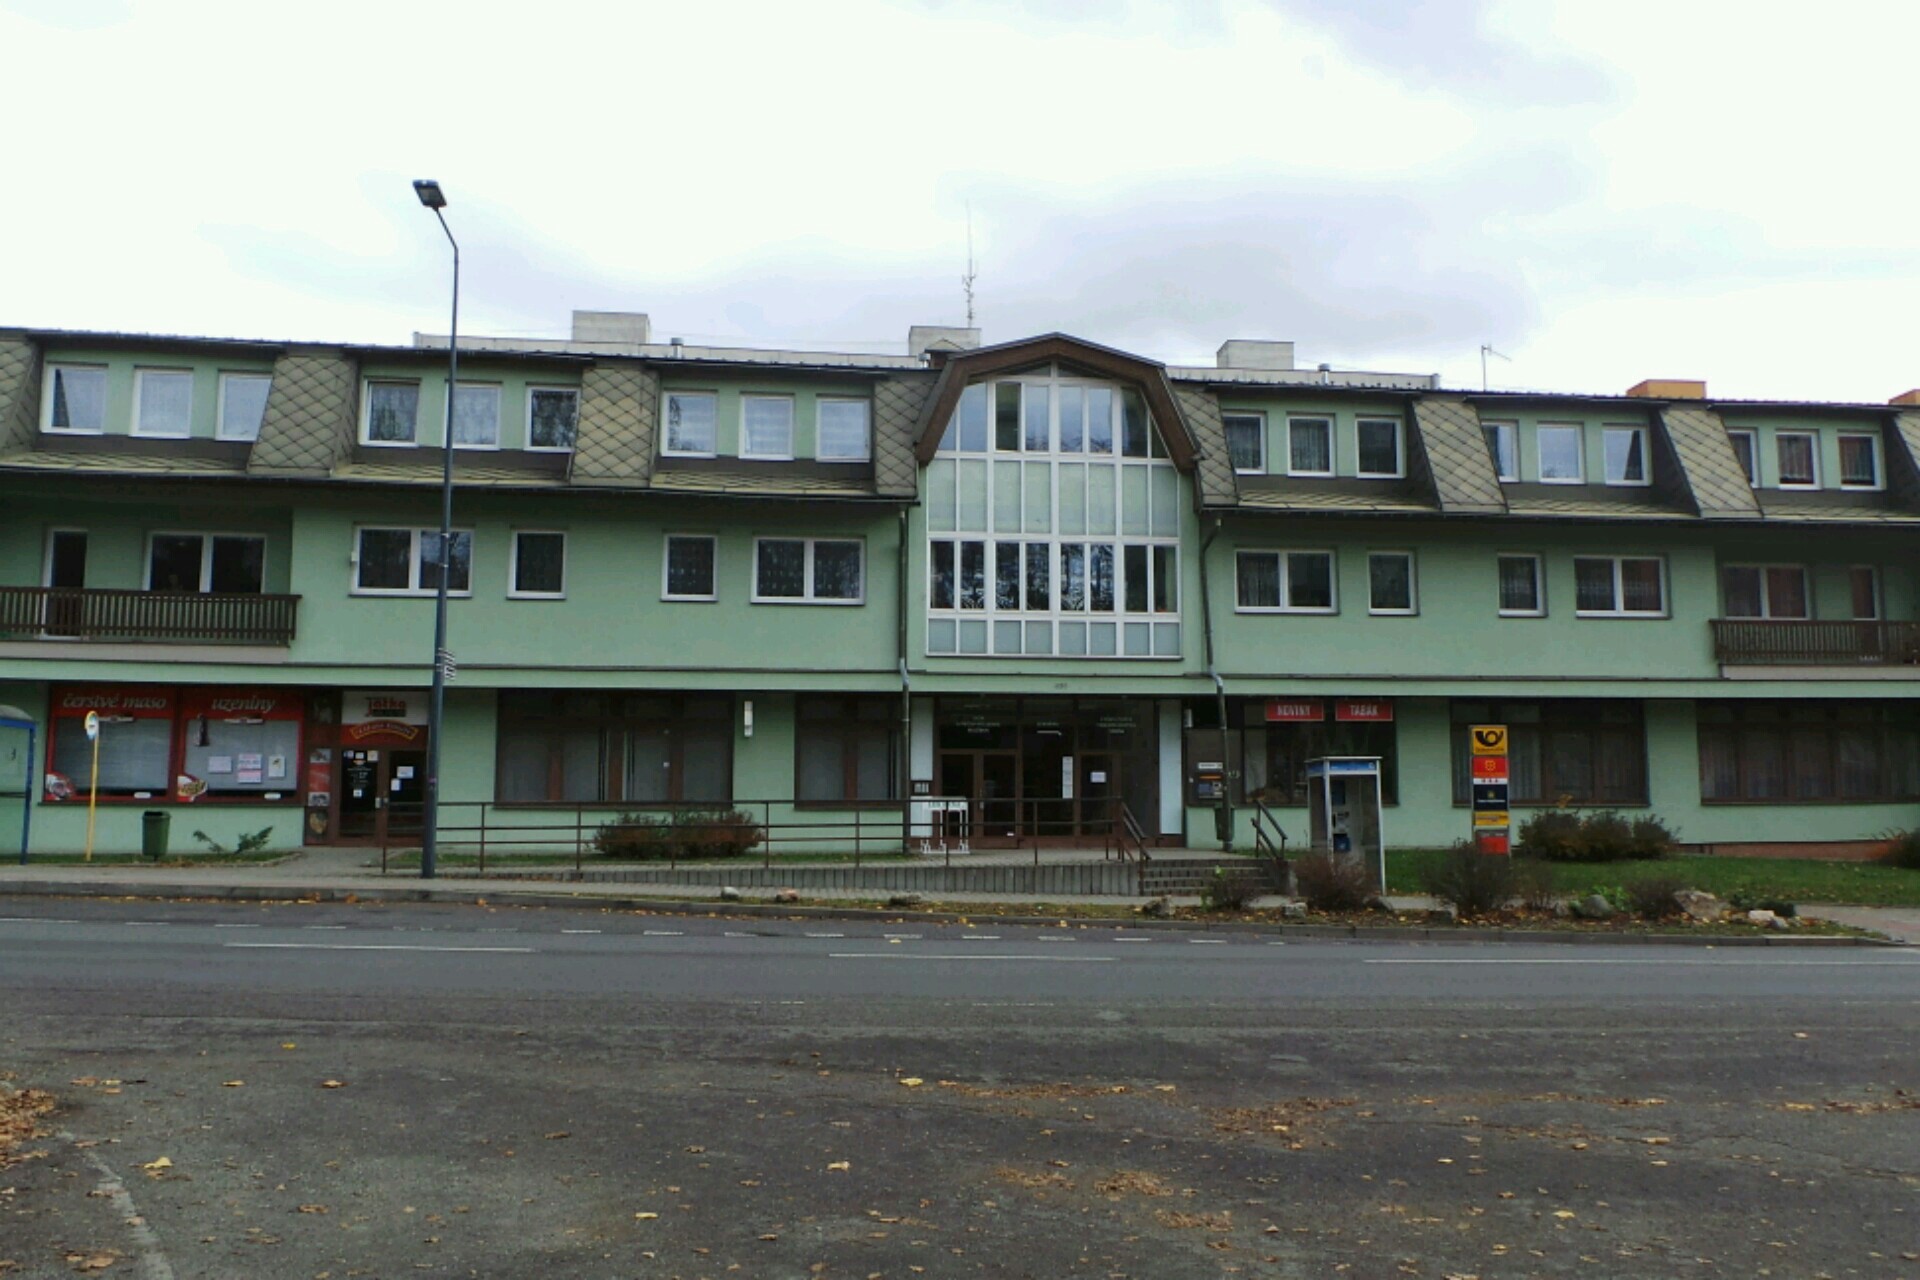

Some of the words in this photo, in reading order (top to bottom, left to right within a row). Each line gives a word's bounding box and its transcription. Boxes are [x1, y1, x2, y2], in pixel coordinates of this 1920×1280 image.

[62, 693, 120, 708] čerstvé
[123, 696, 167, 709] maso
[211, 695, 276, 713] uzeniny
[1276, 704, 1311, 716] NOVINY
